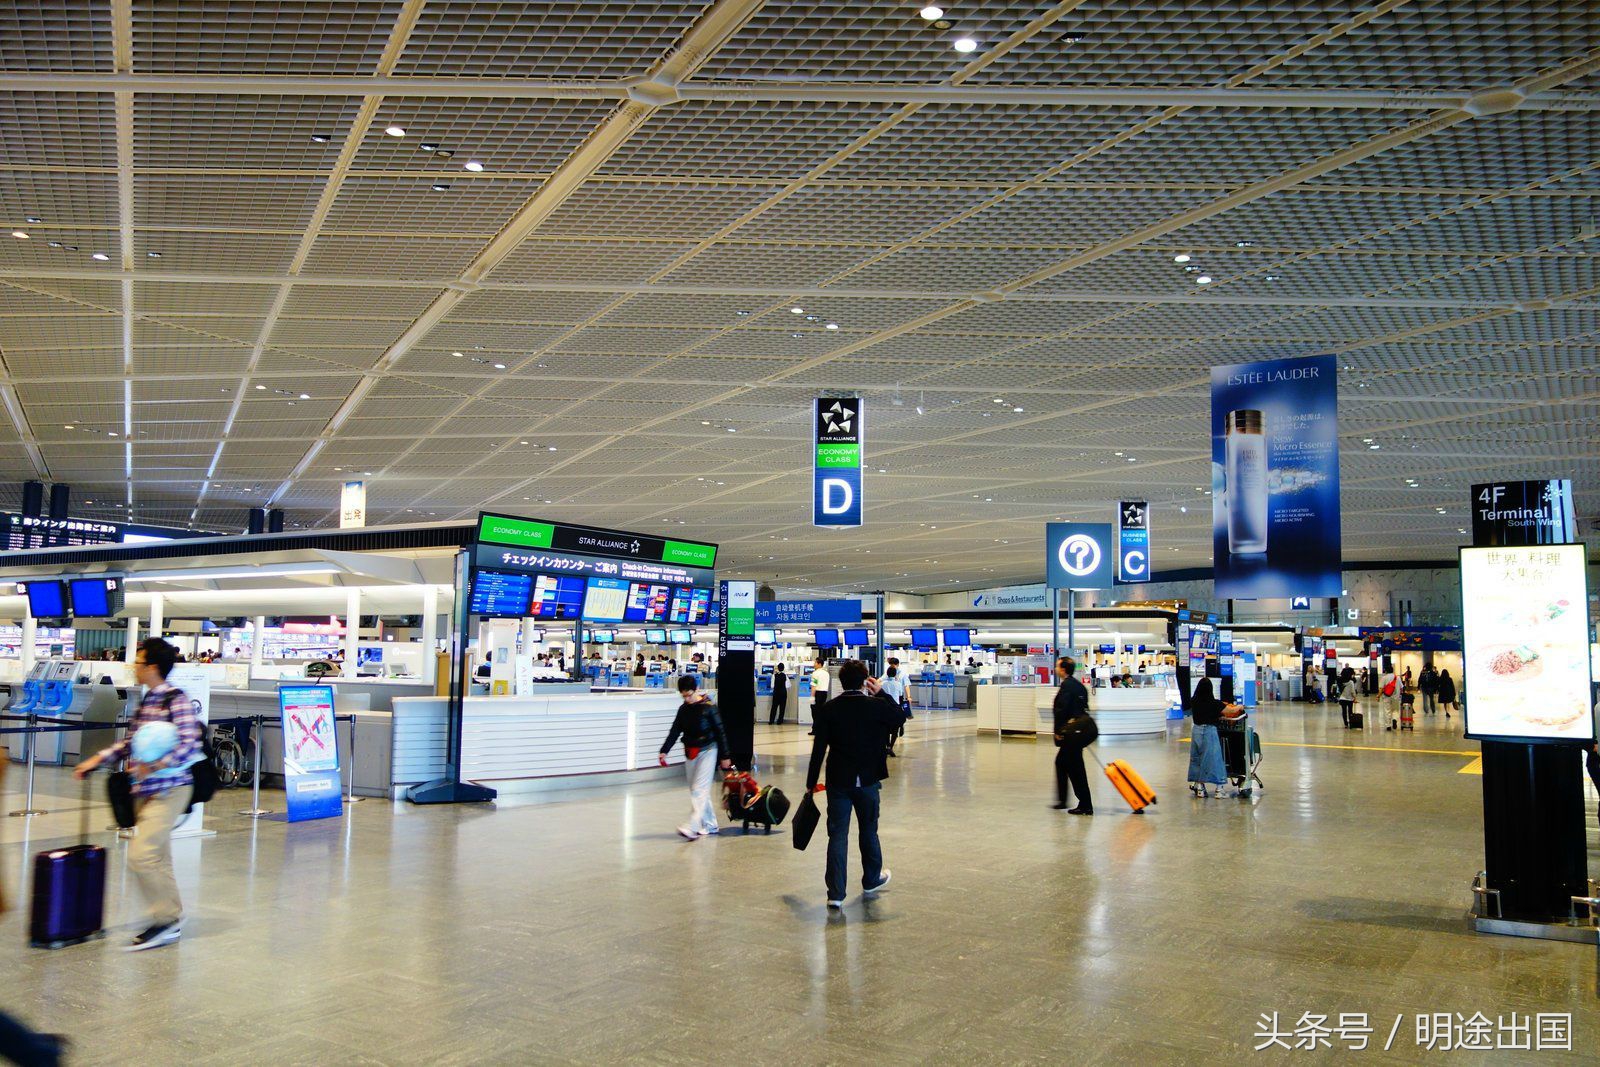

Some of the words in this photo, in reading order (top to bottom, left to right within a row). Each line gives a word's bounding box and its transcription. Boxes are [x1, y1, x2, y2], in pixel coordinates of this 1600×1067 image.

[1267, 367, 1319, 382] LAUDER
[1299, 441, 1332, 450] Essence
[823, 478, 853, 514] D
[1479, 486, 1506, 504] 4F
[1479, 506, 1548, 521] Terminal
[1553, 506, 1560, 518] 1
[1507, 519, 1536, 527] South
[1538, 518, 1562, 528] Wing
[493, 526, 522, 536] ECONOMY
[523, 529, 542, 538] CLASS
[578, 536, 596, 547] STAR
[596, 539, 628, 550] ALLIANCE
[671, 549, 693, 557] ECONOMY
[1124, 550, 1145, 575] C
[720, 594, 728, 635] ALLIANCE
